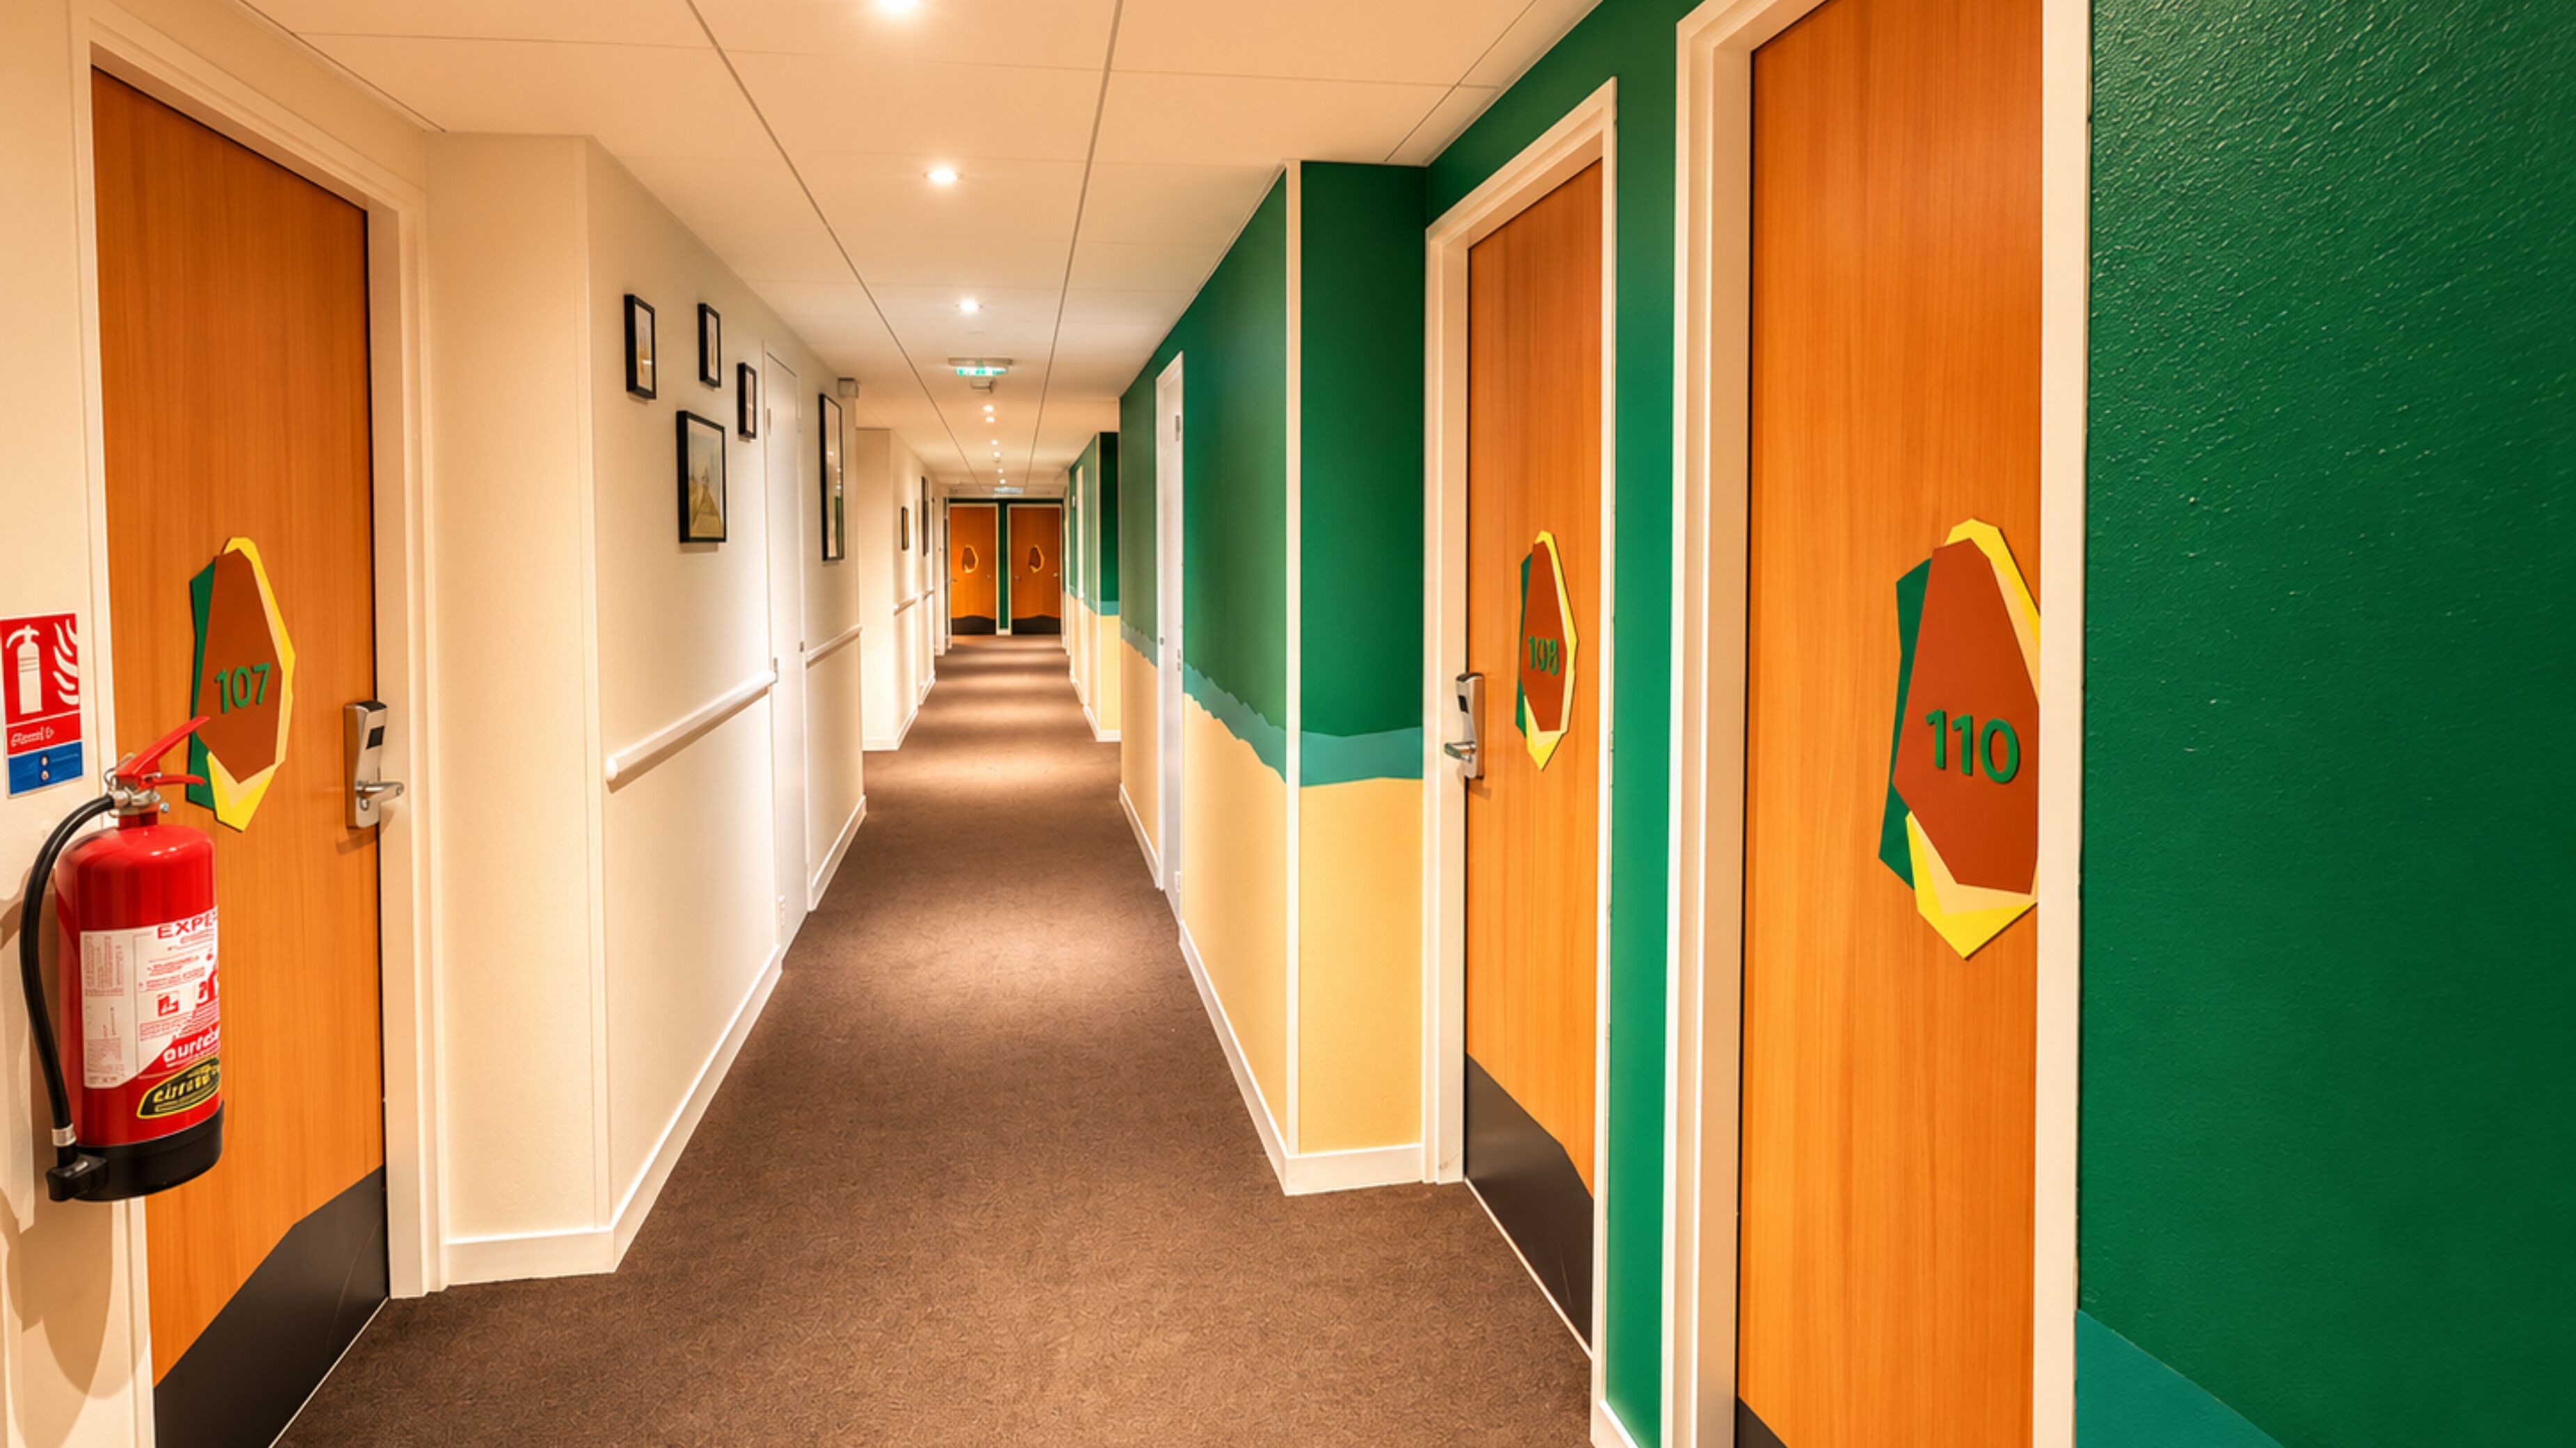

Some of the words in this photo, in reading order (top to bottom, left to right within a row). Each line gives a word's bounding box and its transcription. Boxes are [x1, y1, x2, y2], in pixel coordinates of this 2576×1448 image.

[1528, 635, 1560, 675] 108
[214, 662, 271, 714] 107
[1925, 709, 2021, 784] 110
